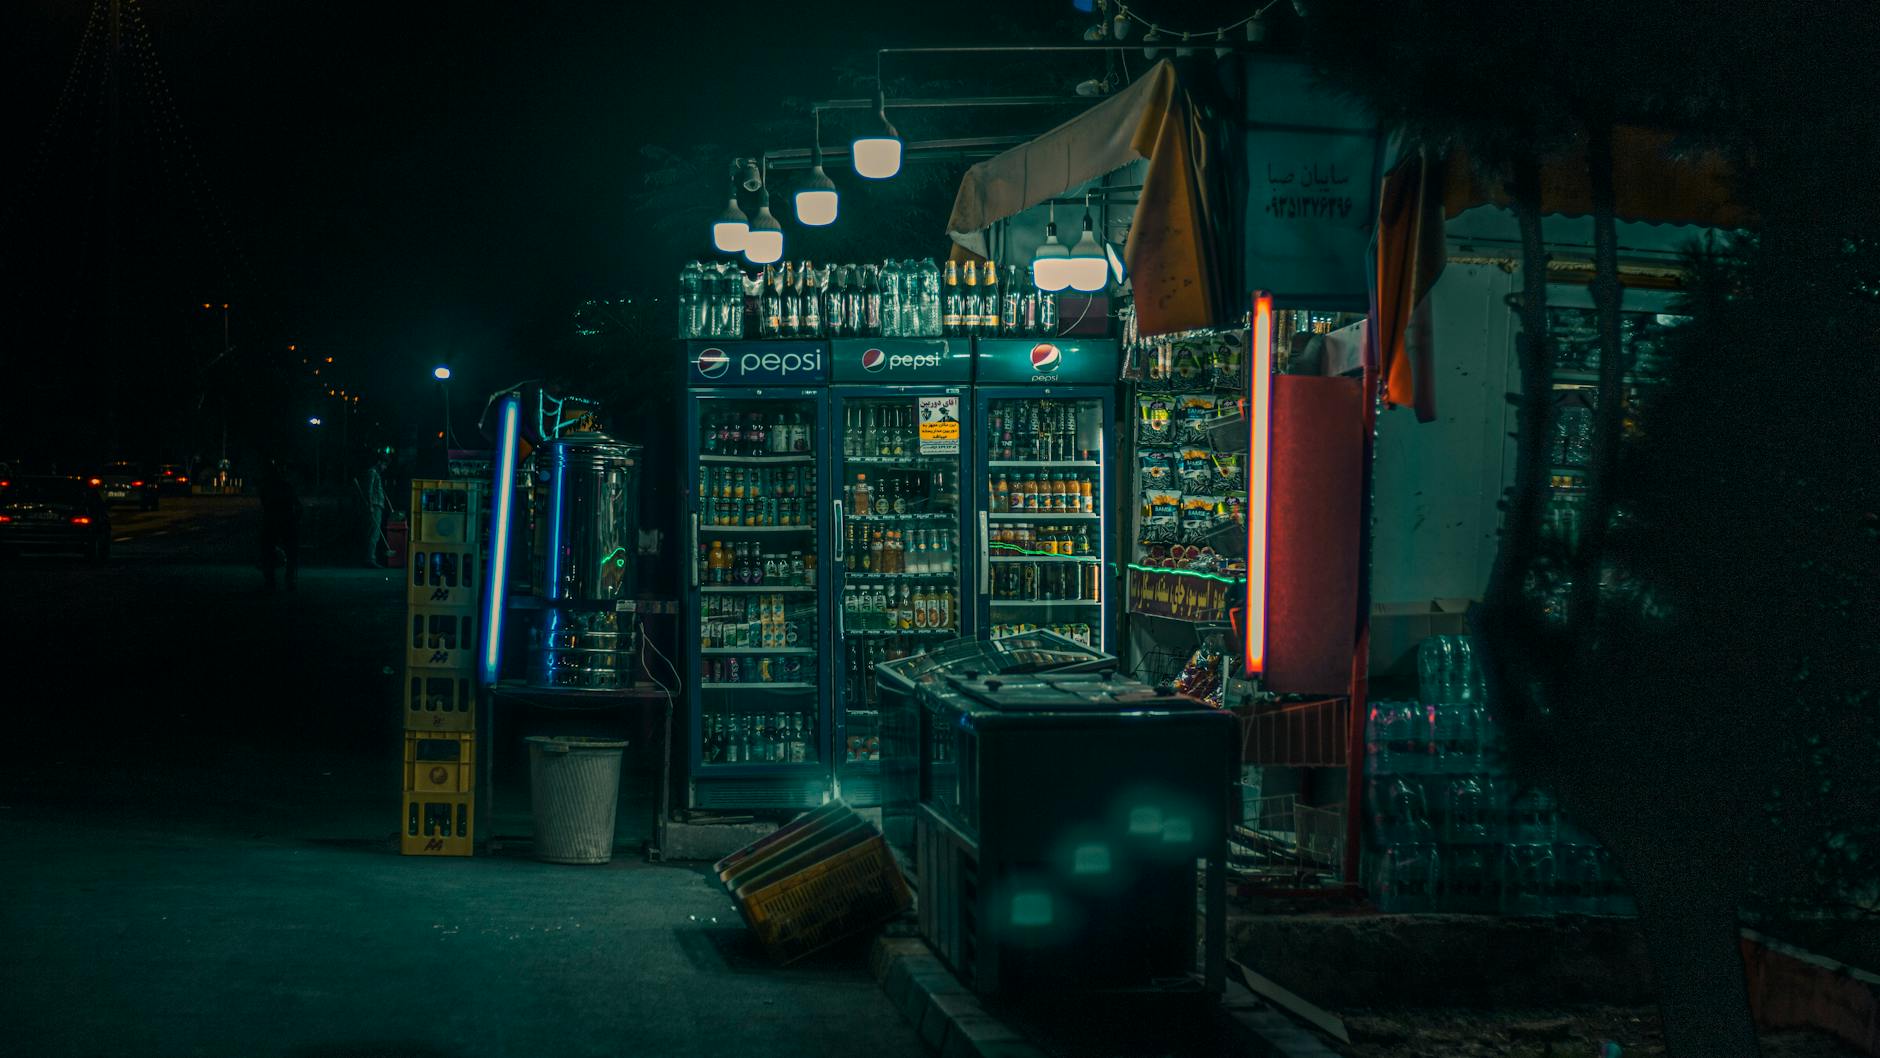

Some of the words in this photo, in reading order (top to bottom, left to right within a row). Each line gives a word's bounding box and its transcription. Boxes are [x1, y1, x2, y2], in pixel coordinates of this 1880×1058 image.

[1267, 162, 1295, 192] صبا
[1301, 162, 1349, 192] سایبان
[741, 349, 821, 375] pepsi
[889, 354, 940, 369] pepsi
[1031, 374, 1059, 382] pepsi
